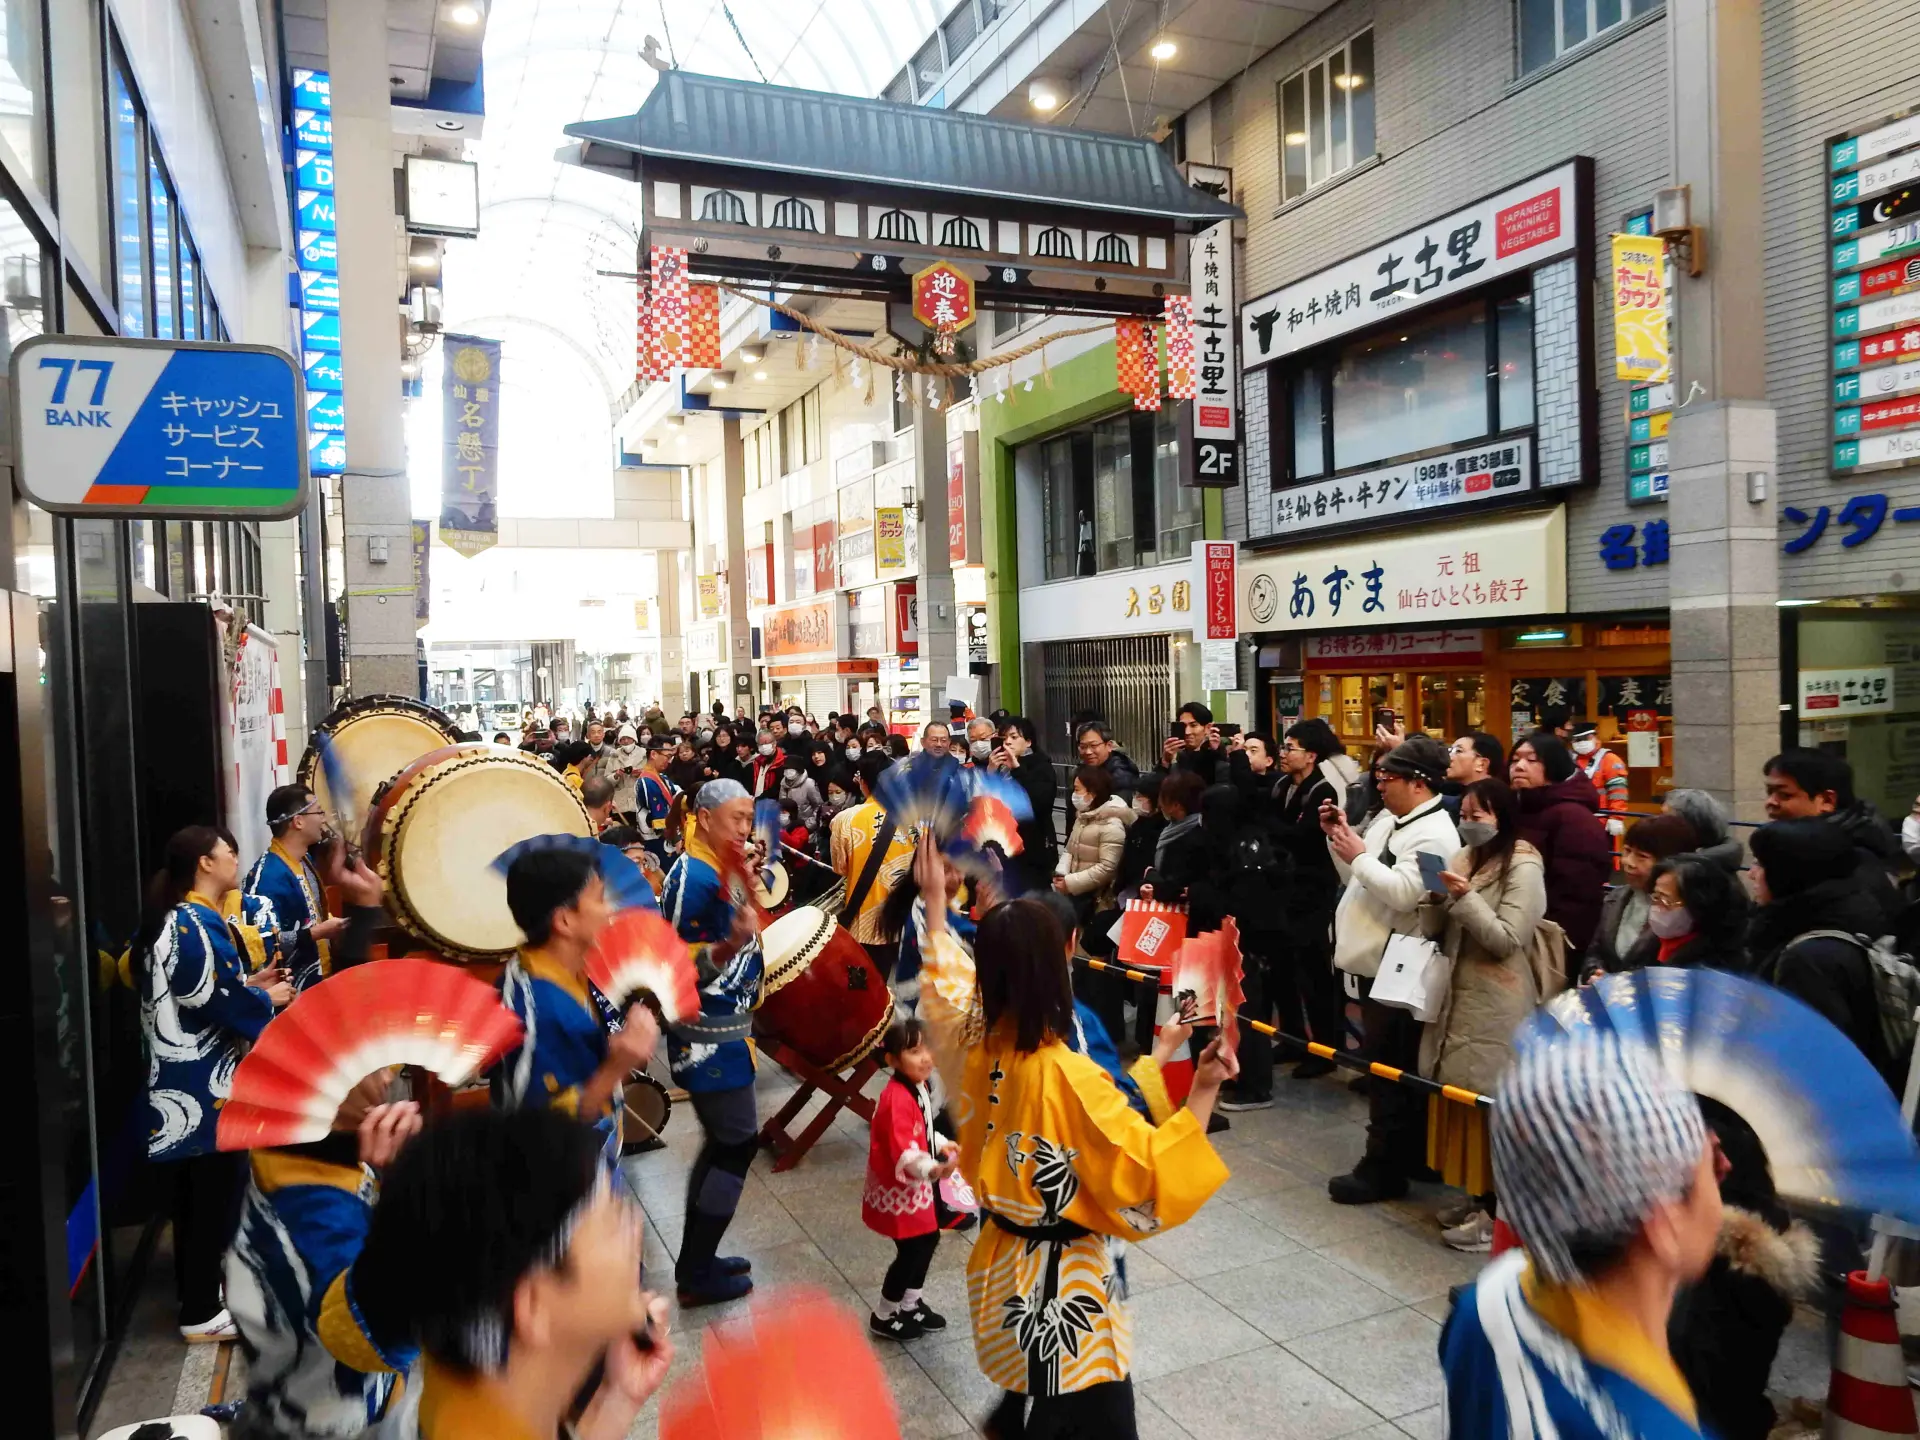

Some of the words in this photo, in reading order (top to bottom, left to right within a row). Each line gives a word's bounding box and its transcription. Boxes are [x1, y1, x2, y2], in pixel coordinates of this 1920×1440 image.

[1836, 146, 1854, 163] 2F
[1865, 168, 1898, 187] Bar
[1833, 179, 1857, 199] 2F
[1501, 196, 1553, 225] JAPANESE
[1506, 211, 1549, 235] YAKINIKU
[1833, 213, 1858, 232] 2F
[1500, 222, 1556, 251] VEGETABLE
[1837, 247, 1856, 263] 2F
[1287, 282, 1361, 334] 和牛焼肉
[1370, 219, 1488, 302] 土古里
[1616, 267, 1660, 289] ホーム
[932, 272, 958, 325] 迎春
[1617, 288, 1660, 309] タウン
[1838, 281, 1856, 296] 2F
[1838, 314, 1856, 328] 1F
[1201, 303, 1228, 394] 土古里
[1838, 347, 1856, 360] 1F
[38, 357, 114, 406] 77
[1836, 380, 1858, 397] 1F
[160, 391, 283, 419] キャッシュ
[1632, 395, 1648, 409] 1F
[45, 408, 112, 428] BANK
[1840, 415, 1858, 428] 1F
[162, 423, 264, 449] サービス
[1635, 423, 1648, 435] 1F
[1200, 444, 1232, 474] 2F
[1634, 452, 1648, 464] 1F
[1838, 447, 1856, 460] 1F
[165, 456, 264, 479] コーナー
[1416, 479, 1461, 501] 年中無休
[1634, 481, 1648, 492] 1F
[1295, 477, 1409, 521] 仙台牛・牛タン
[879, 520, 902, 529] ホーム
[880, 529, 902, 537] タウン
[949, 524, 962, 546] 2F
[1210, 559, 1231, 570] 仙台
[1437, 551, 1481, 577] 元祖
[1213, 572, 1227, 624] ひとくち
[1289, 559, 1386, 619] あずま
[1397, 578, 1529, 611] 仙台ひとくち餃子
[1210, 625, 1232, 637] 餃子
[1318, 630, 1475, 655] お持ち帰りコーナー
[1511, 679, 1567, 706] 定食
